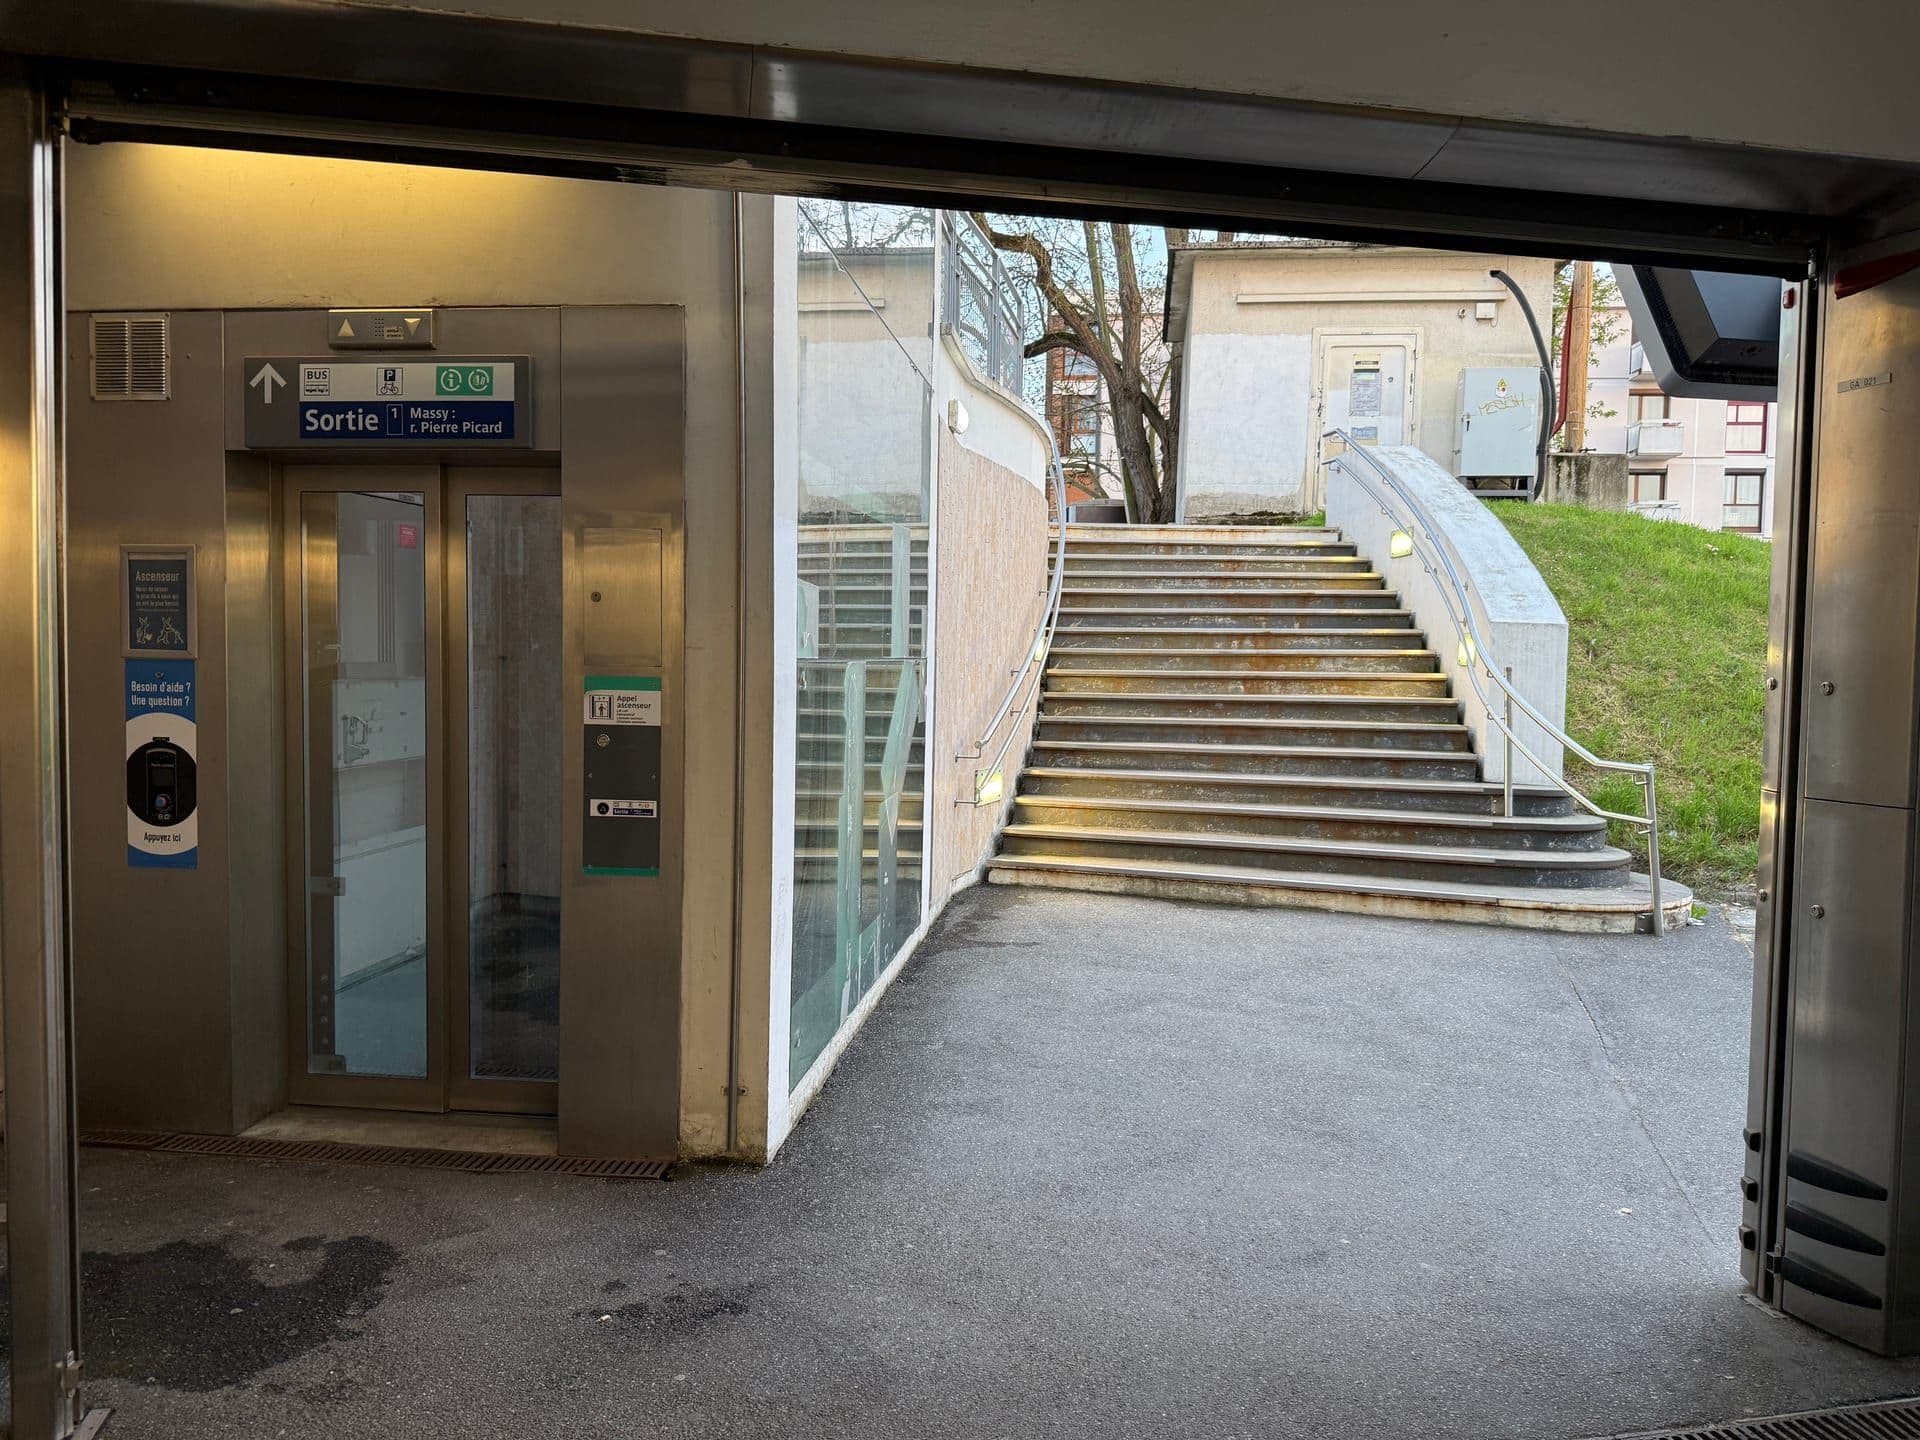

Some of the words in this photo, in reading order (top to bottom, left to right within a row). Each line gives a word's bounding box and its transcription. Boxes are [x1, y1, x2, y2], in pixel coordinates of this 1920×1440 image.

[307, 370, 327, 380] BUS
[386, 370, 394, 380] P
[305, 408, 379, 431] Sortie
[391, 408, 397, 419] 1
[410, 408, 449, 421] Massy
[410, 423, 417, 433] r.
[421, 421, 458, 433] Pierre
[462, 421, 502, 433] Picard
[131, 681, 157, 692] Besoin
[159, 682, 184, 693] d'aide
[186, 682, 191, 693] ?
[131, 695, 146, 705] Une
[148, 696, 183, 708] question
[184, 696, 190, 707] ?
[617, 695, 637, 703] Appel
[143, 832, 171, 844] Appuyez
[172, 832, 181, 842] ici
